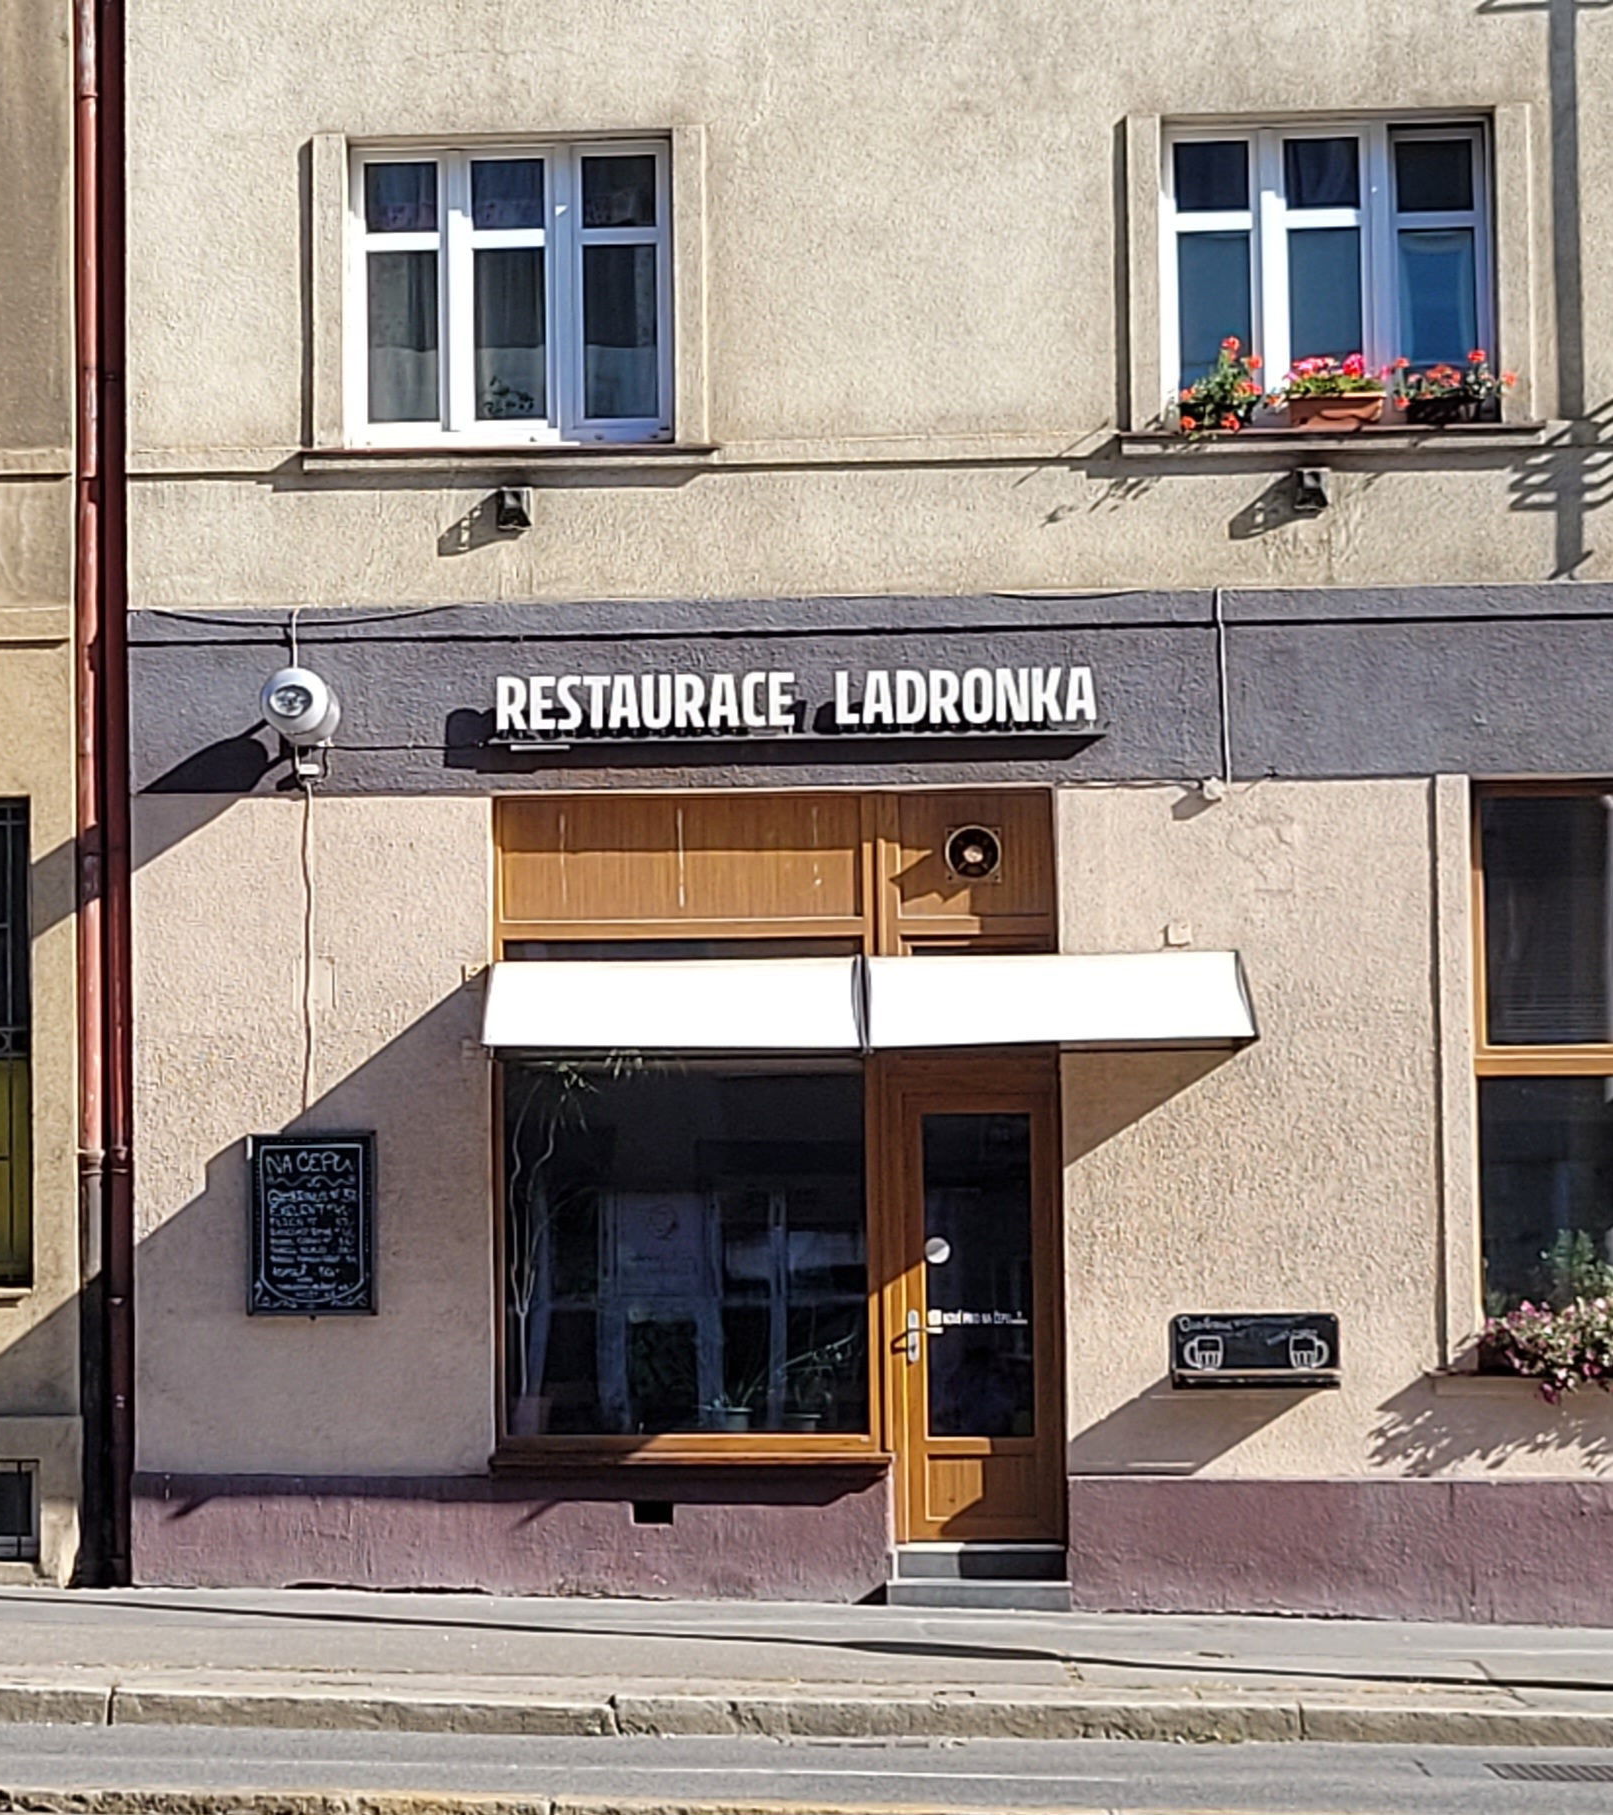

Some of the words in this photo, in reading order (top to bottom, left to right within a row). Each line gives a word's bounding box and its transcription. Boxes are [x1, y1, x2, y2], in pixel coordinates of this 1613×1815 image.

[495, 671, 796, 731] RESTAURACE
[834, 666, 1097, 725] LADRONKA
[265, 1154, 293, 1174] NA
